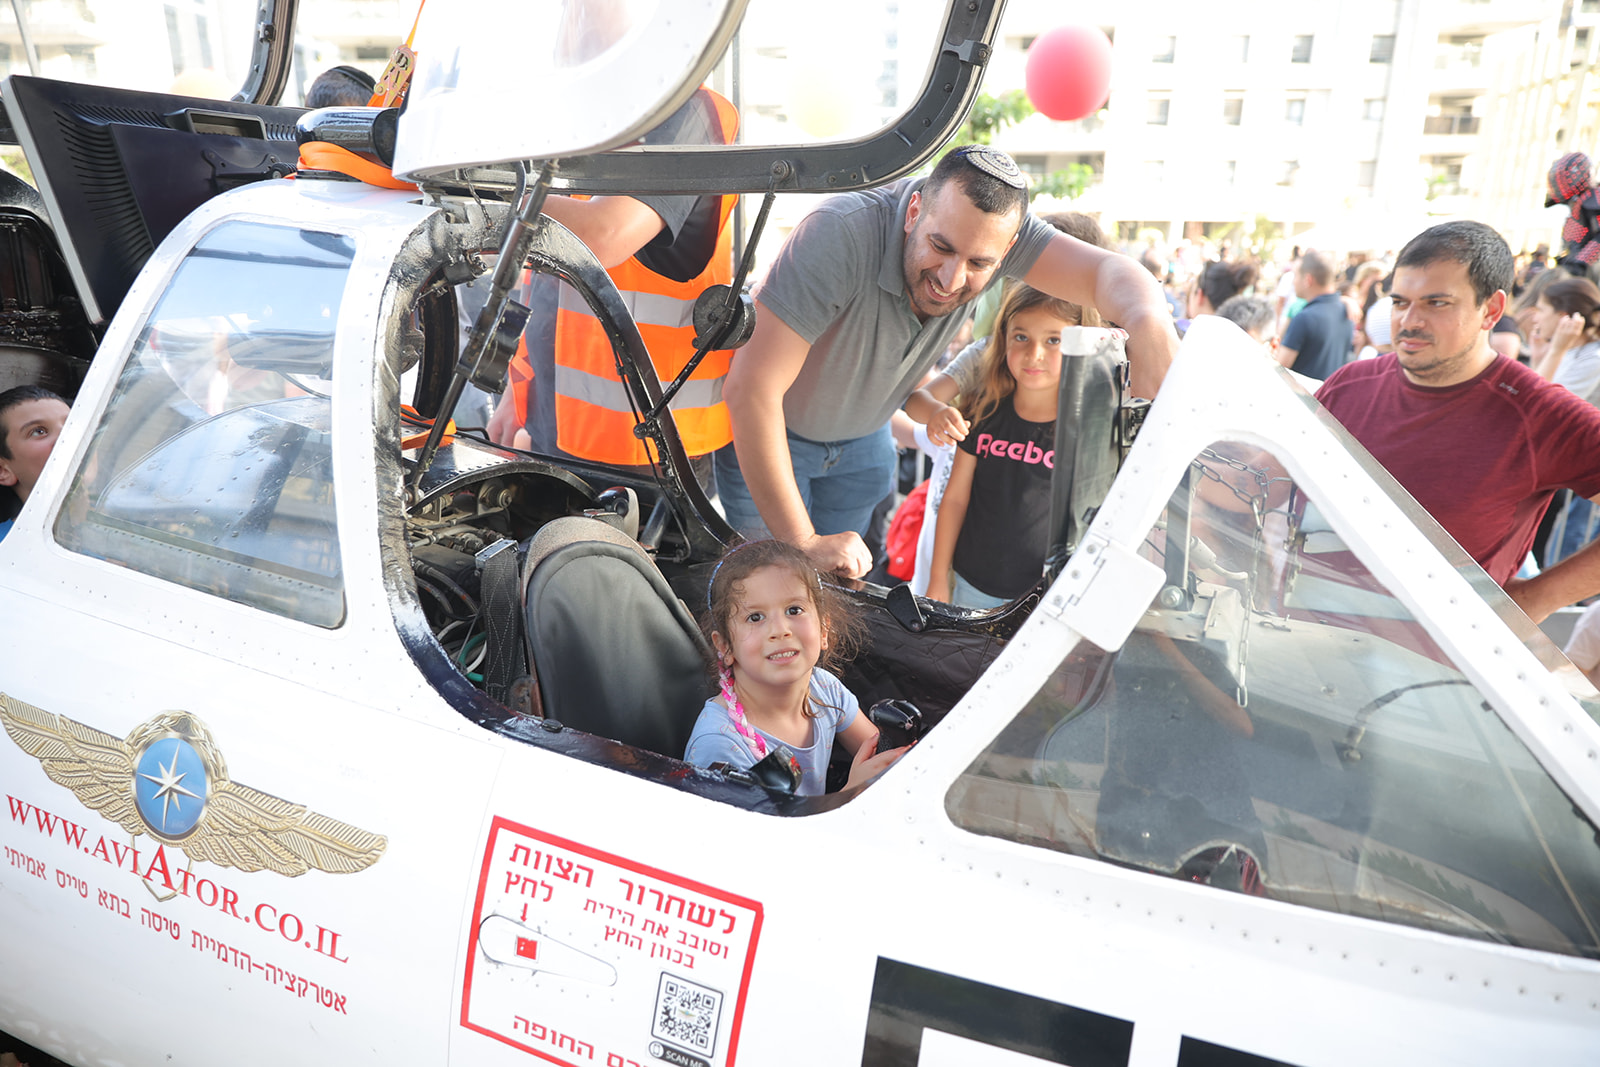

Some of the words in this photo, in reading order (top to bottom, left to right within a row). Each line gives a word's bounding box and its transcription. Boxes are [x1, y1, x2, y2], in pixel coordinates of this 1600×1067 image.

[976, 433, 1055, 469] Reebo
[4, 846, 47, 880] אמיתי
[509, 843, 594, 888] הצוות
[56, 869, 88, 898] טייס
[504, 871, 553, 902] לחץ
[98, 888, 131, 919] בתא
[583, 898, 635, 927] הידית
[619, 878, 736, 934] לשחרור
[141, 907, 180, 940] טיסה
[604, 925, 643, 950] החץ
[641, 919, 669, 938] את
[650, 942, 695, 969] בכוון
[677, 930, 729, 959] וסובב
[513, 1015, 594, 1060] החופה
[665, 1050, 688, 1066] SCAN
